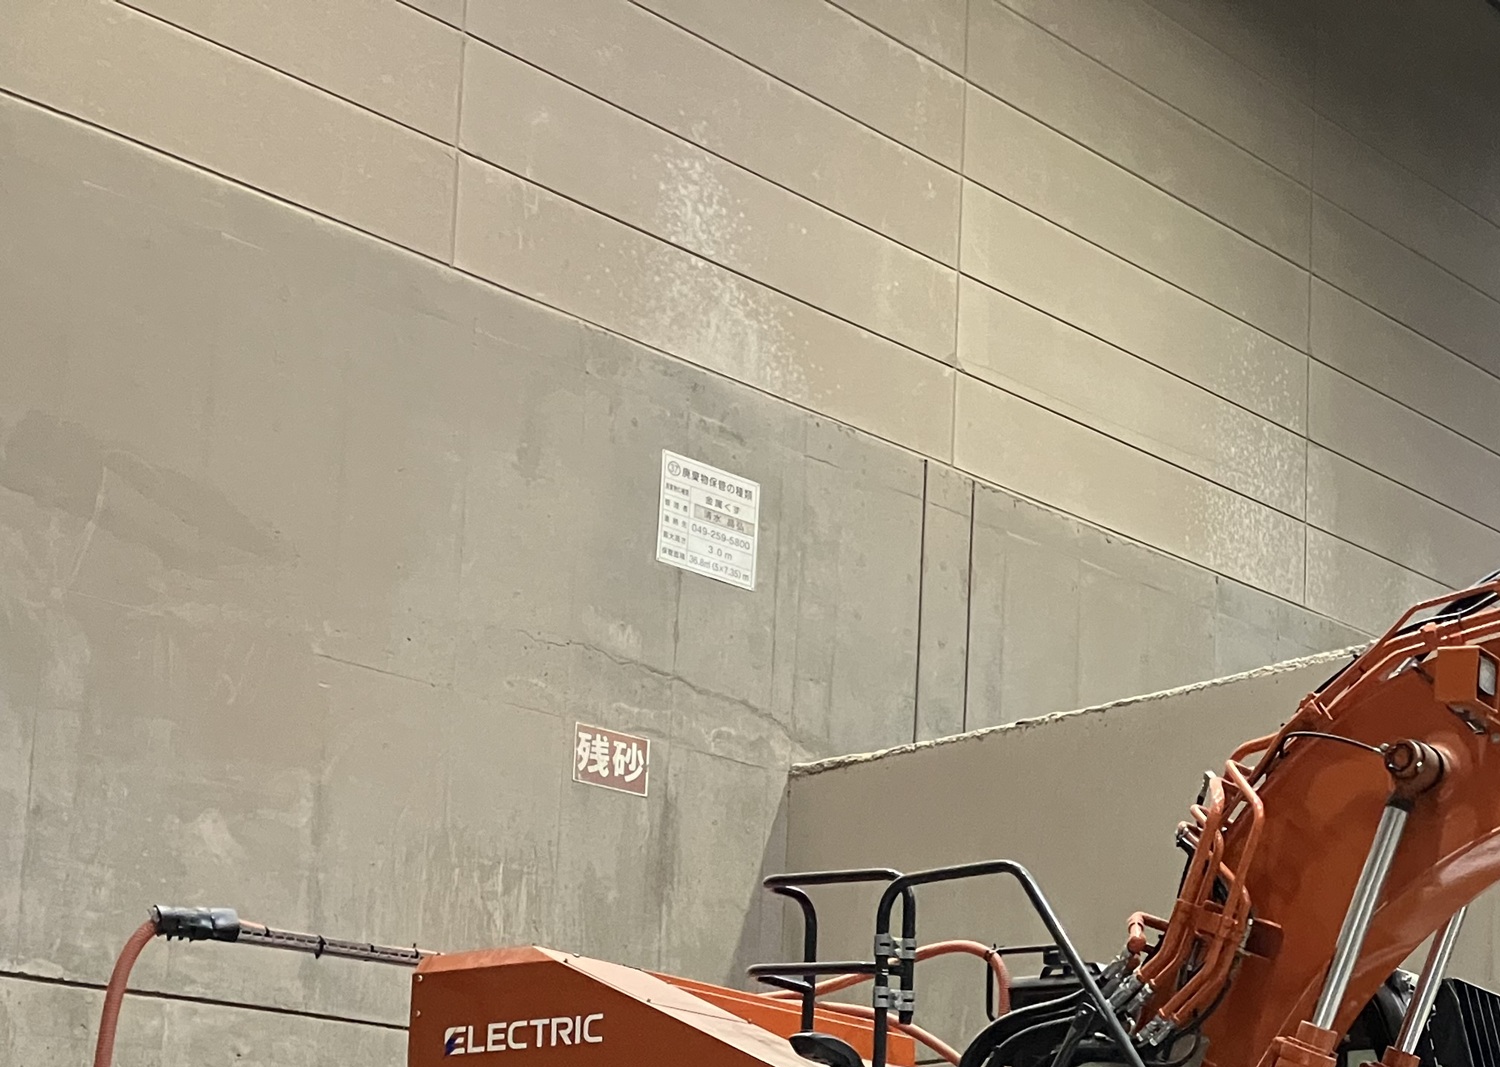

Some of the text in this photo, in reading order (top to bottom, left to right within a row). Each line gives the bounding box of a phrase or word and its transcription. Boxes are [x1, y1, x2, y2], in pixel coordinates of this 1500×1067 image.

[691, 524, 750, 550] 049-259-5800
[577, 732, 644, 782] 残砂
[443, 1014, 603, 1056] ELECTRIC
